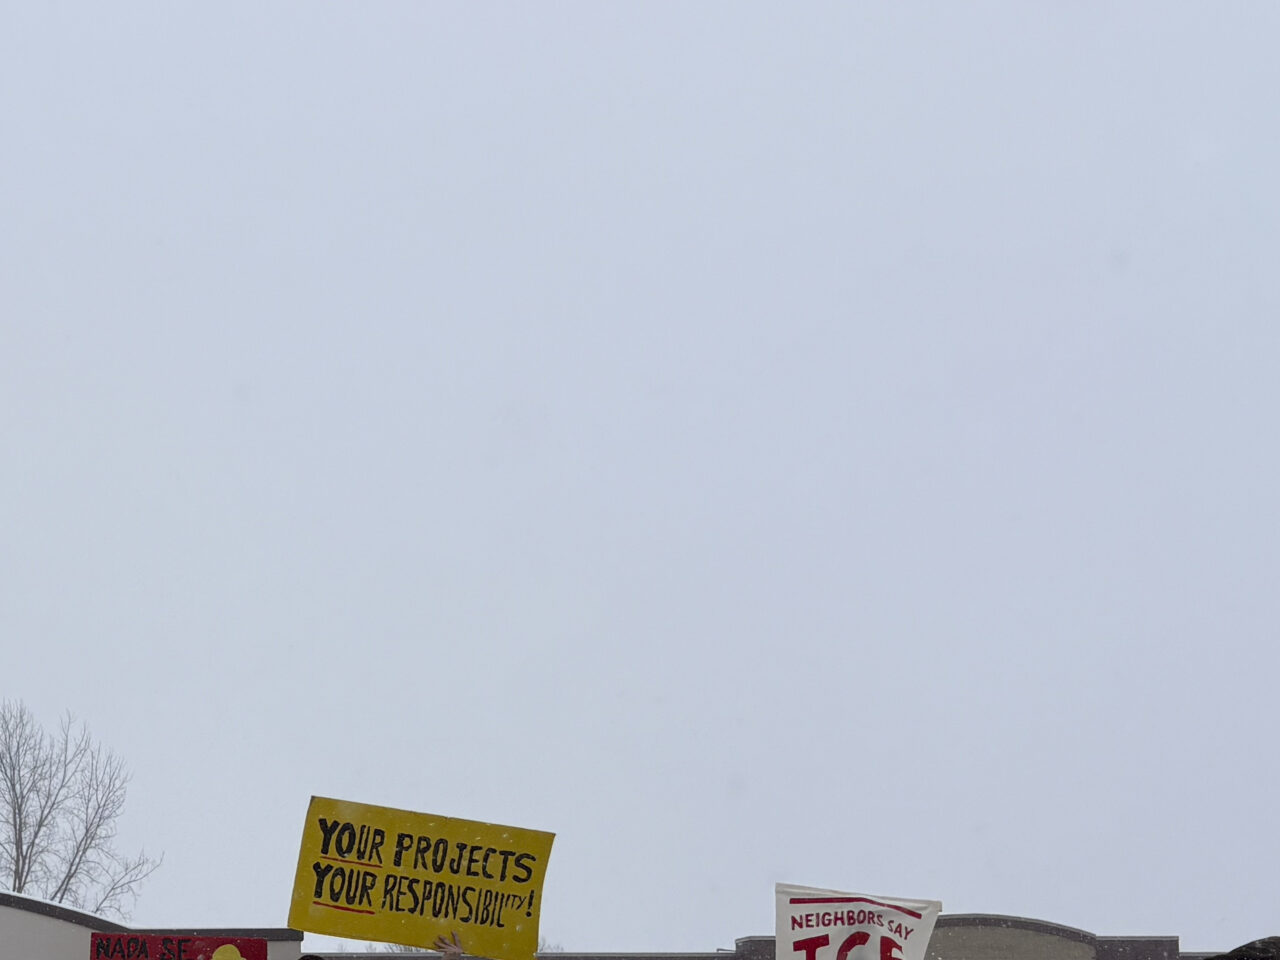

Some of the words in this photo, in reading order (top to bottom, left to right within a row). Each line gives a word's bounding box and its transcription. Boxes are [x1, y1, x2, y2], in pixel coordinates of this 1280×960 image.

[318, 818, 385, 864] YOUR
[393, 833, 537, 884] PROJECTS
[312, 861, 378, 907] YOUR
[381, 873, 535, 928] RESPONSIBILITY!
[96, 938, 149, 960] NADA
[791, 910, 884, 930] NEIGHBORS
[887, 920, 914, 940] SAY
